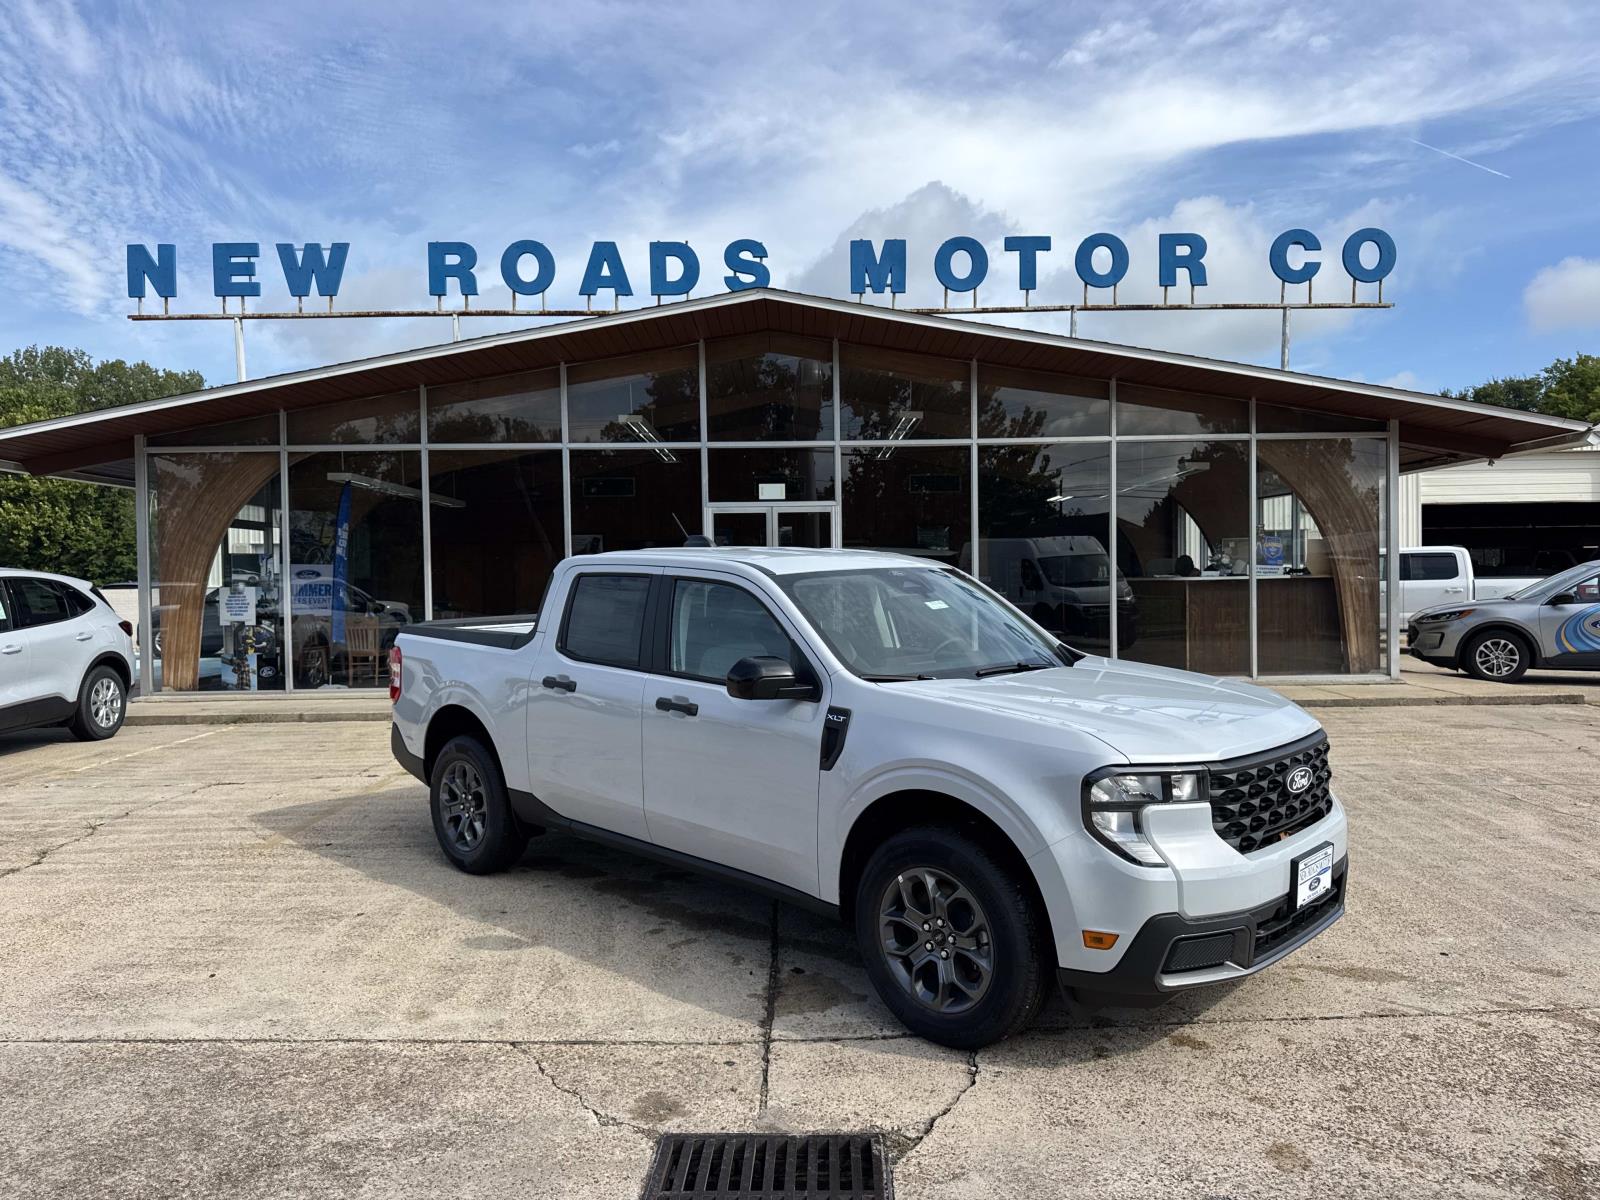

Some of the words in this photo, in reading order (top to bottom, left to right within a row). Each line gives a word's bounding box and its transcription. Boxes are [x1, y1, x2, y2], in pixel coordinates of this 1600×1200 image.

[126, 242, 349, 298] NEW
[427, 239, 771, 297] ROADS
[850, 232, 1208, 295] MOTOR
[1269, 228, 1397, 284] CO
[827, 713, 846, 722] XLT
[1291, 770, 1310, 790] Ford
